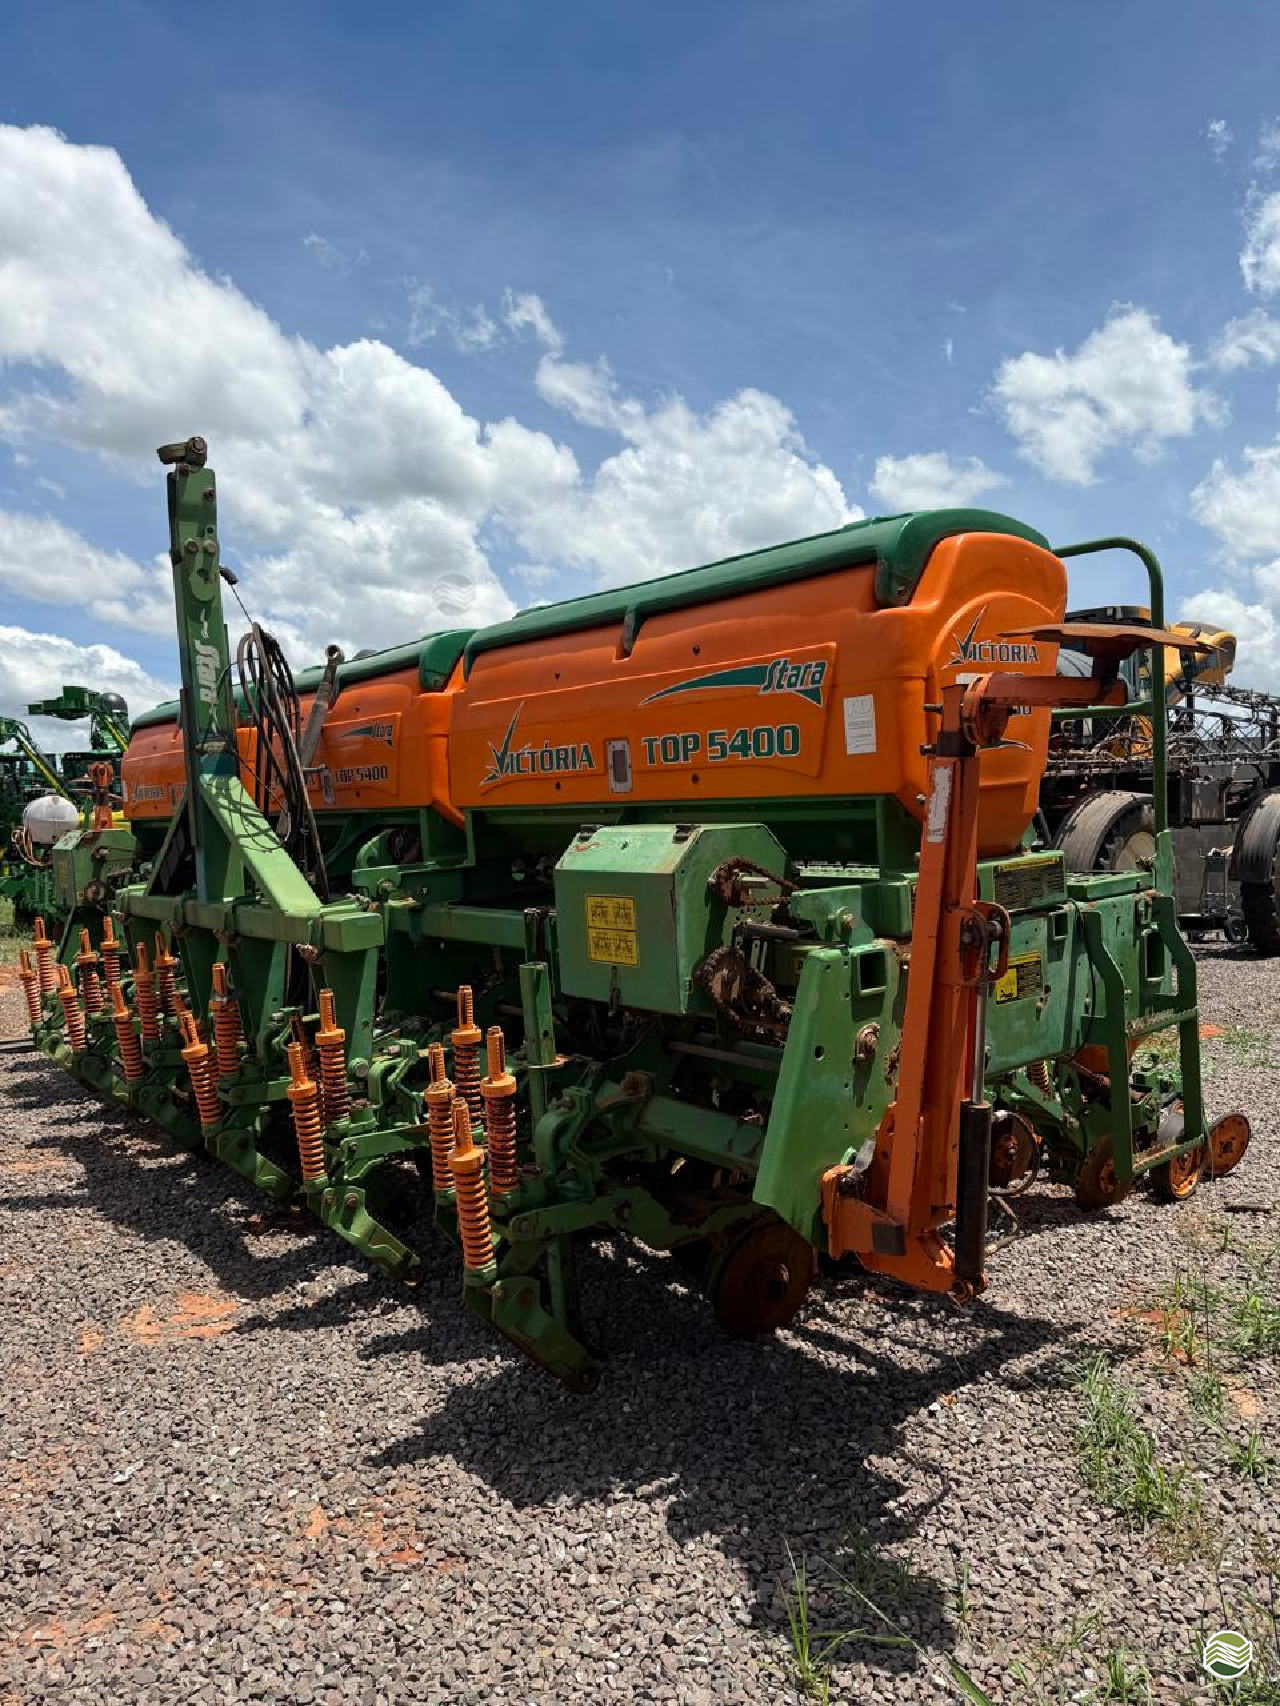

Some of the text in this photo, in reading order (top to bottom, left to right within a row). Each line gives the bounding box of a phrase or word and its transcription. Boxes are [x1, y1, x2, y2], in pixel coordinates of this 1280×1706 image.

[940, 605, 1039, 669] VICTÓRIA
[762, 658, 828, 694] Stara
[480, 702, 596, 786] VICTÓRIA
[641, 724, 800, 766] TOP 5400
[355, 765, 389, 782] 5400
